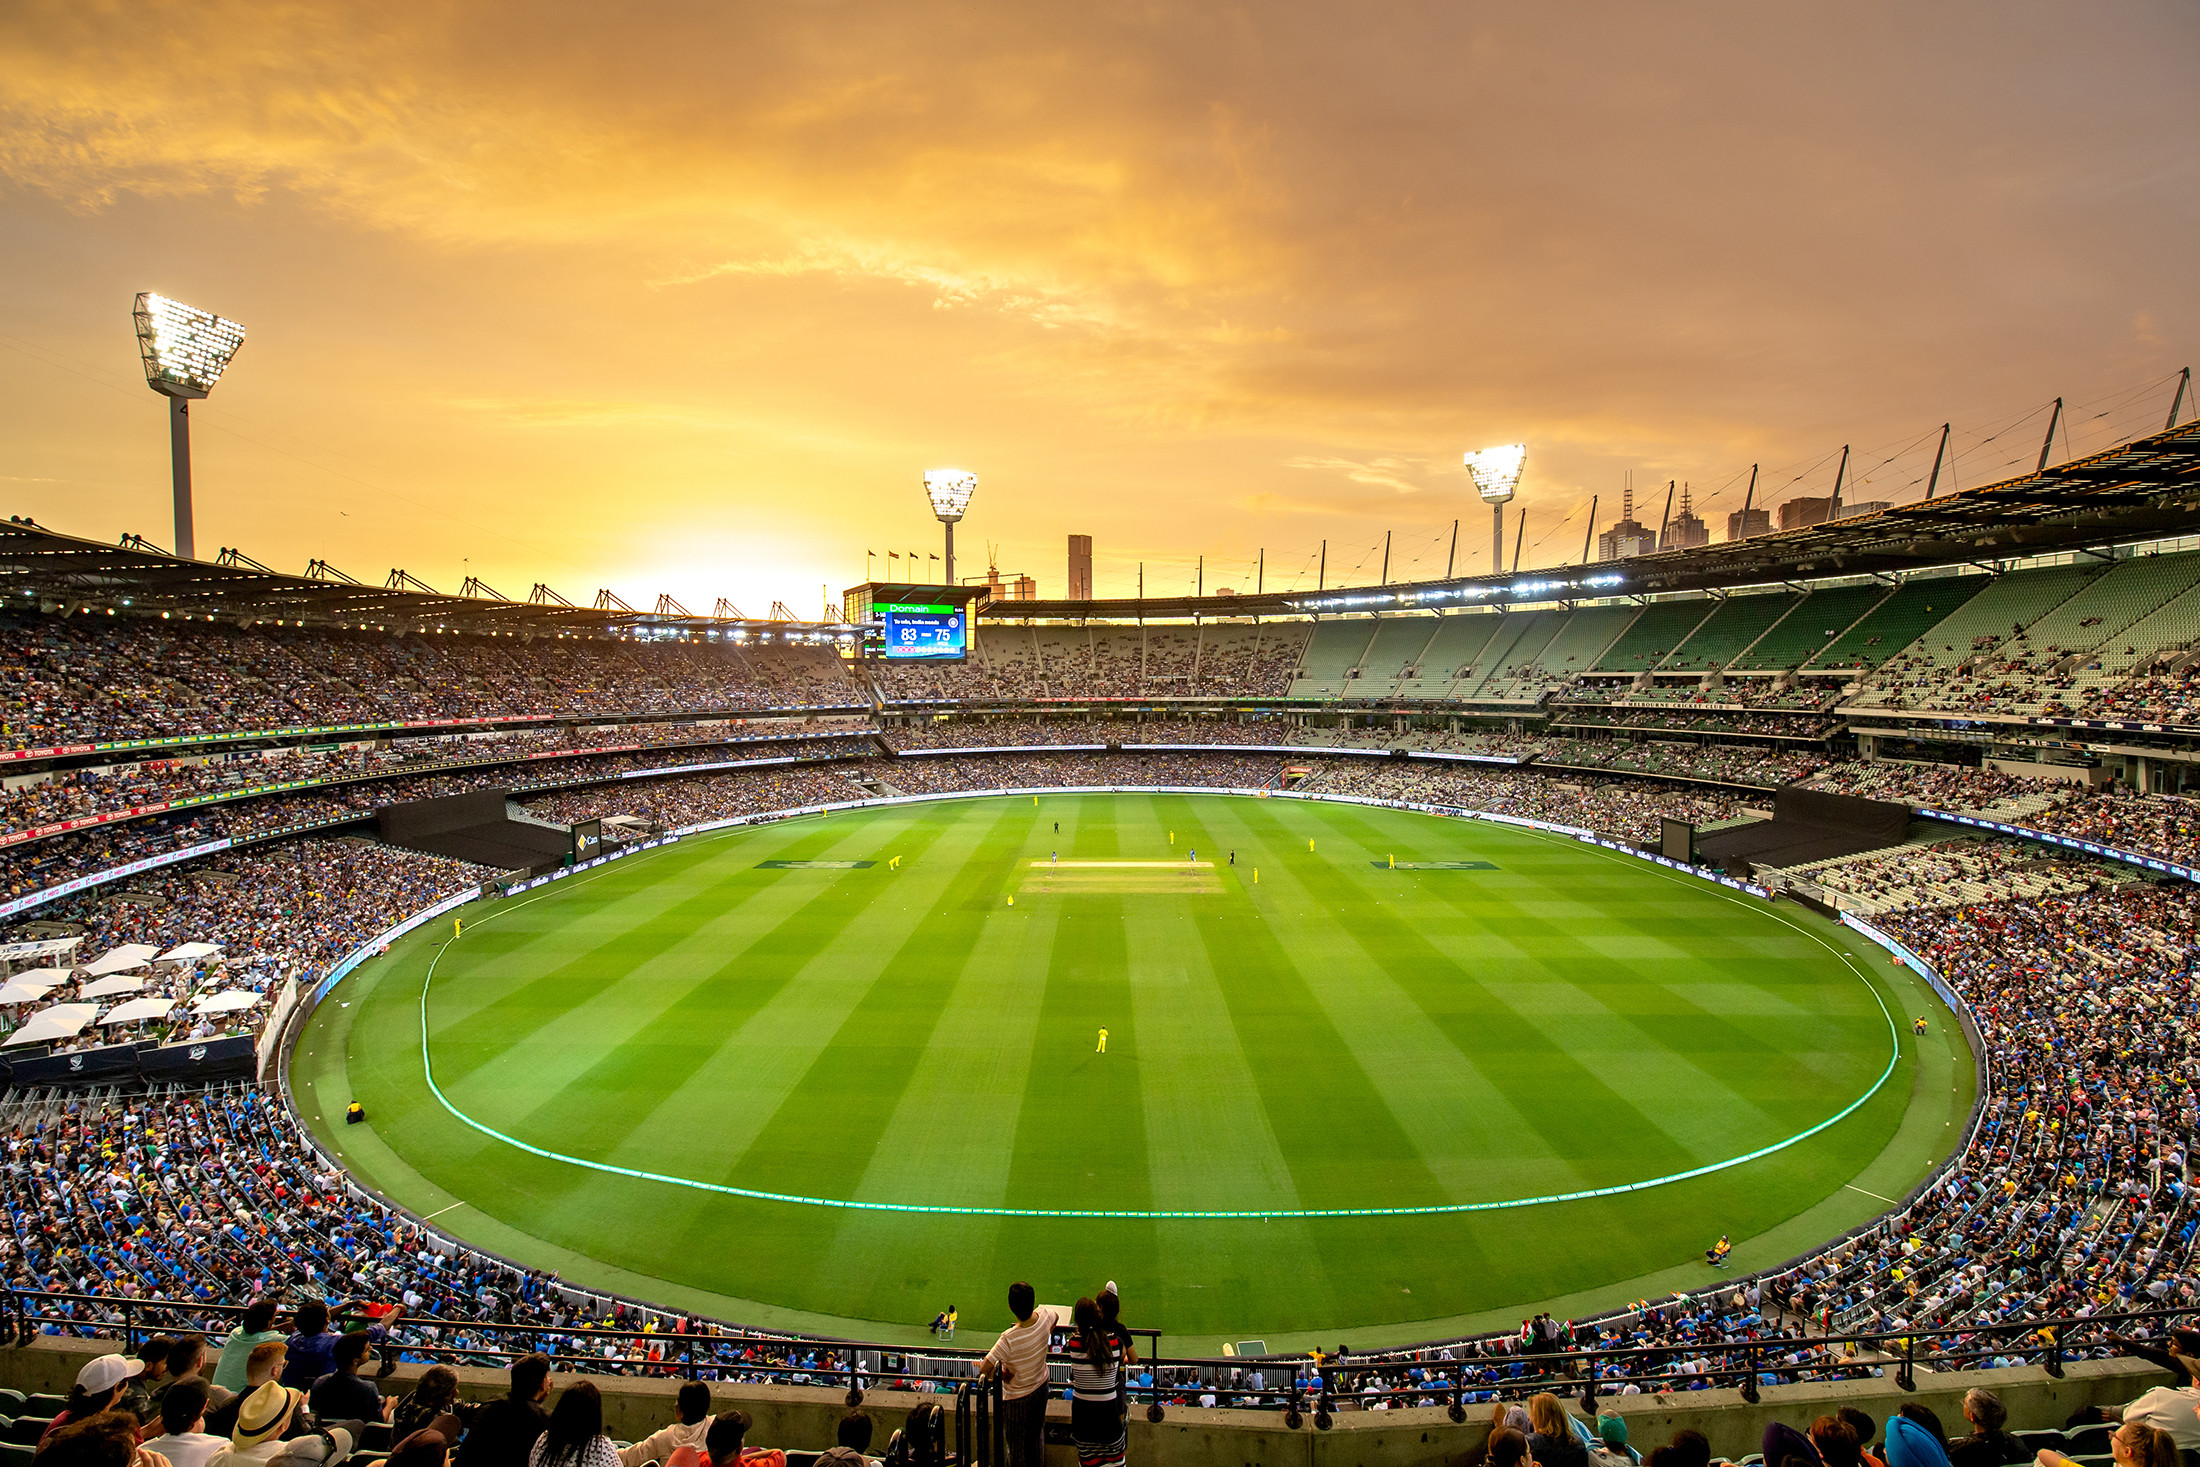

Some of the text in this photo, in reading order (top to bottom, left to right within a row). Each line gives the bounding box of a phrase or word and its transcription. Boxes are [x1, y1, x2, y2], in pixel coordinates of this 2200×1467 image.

[889, 604, 930, 613] Domain
[900, 627, 917, 641] 83
[934, 628, 951, 641] 75
[34, 749, 55, 757] TOYOTA
[71, 745, 91, 753] TOYOTA
[8, 804, 166, 843] TOYOTA TOYOTA TOYOTA TOYOTA TOYOTA
[587, 835, 599, 846] Can
[508, 834, 679, 896] Gillette Gillette Gillette Gillette Gillette Gillette Gillette Gillette Gillette
